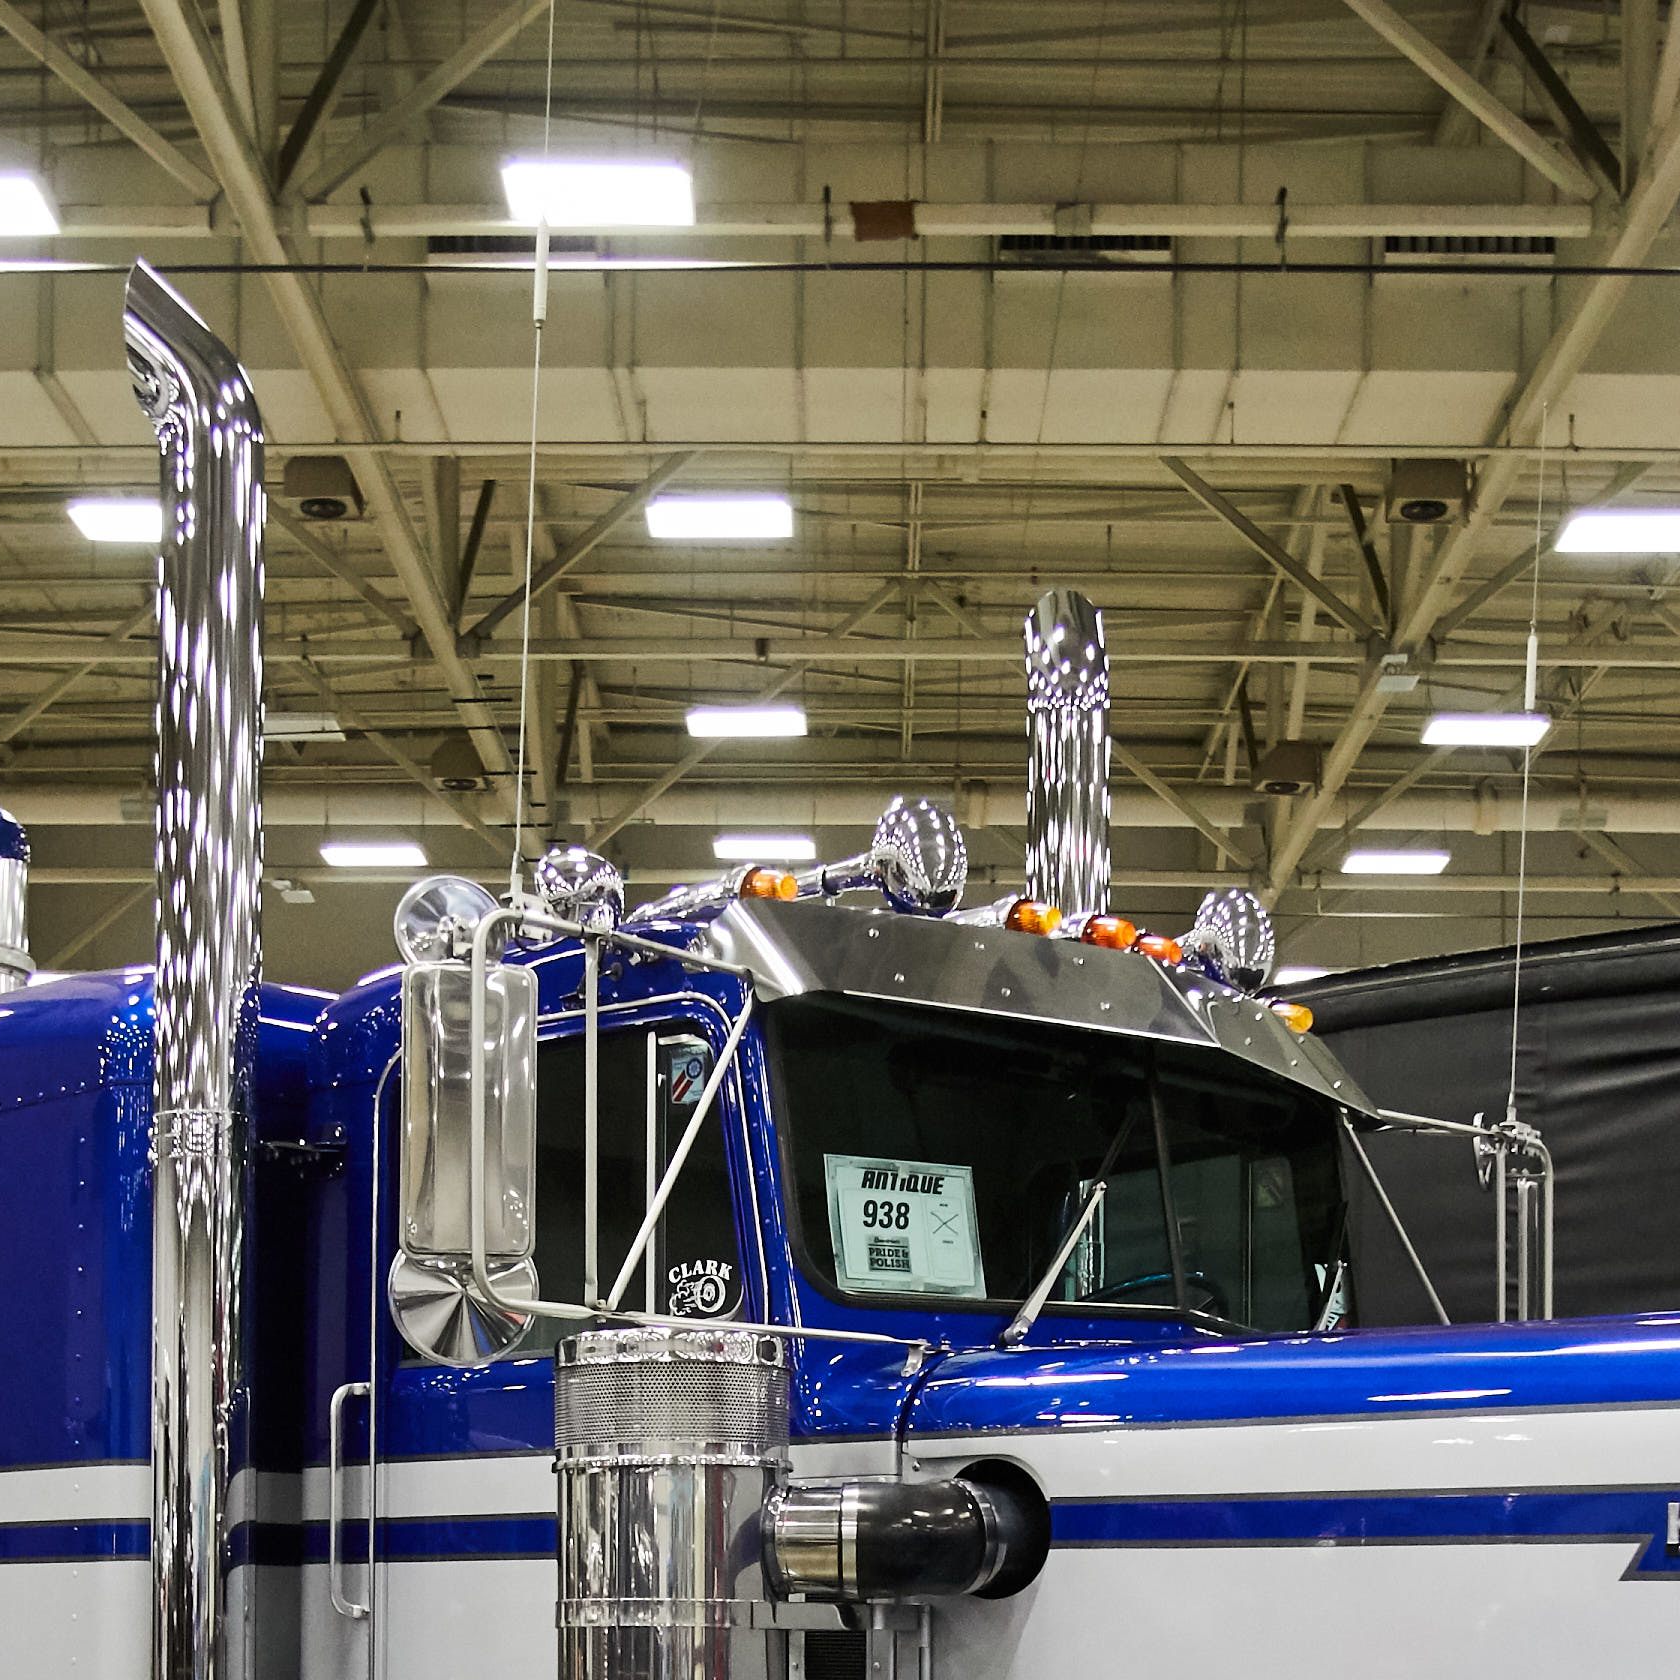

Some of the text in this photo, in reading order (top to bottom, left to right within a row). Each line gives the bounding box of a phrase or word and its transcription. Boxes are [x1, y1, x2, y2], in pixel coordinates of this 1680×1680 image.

[861, 1170, 945, 1195] ANTIQUE
[863, 1199, 910, 1230] 938
[868, 1247, 901, 1258] PRIDE
[869, 1257, 911, 1269] POLISH
[668, 1259, 733, 1284] CLARK
